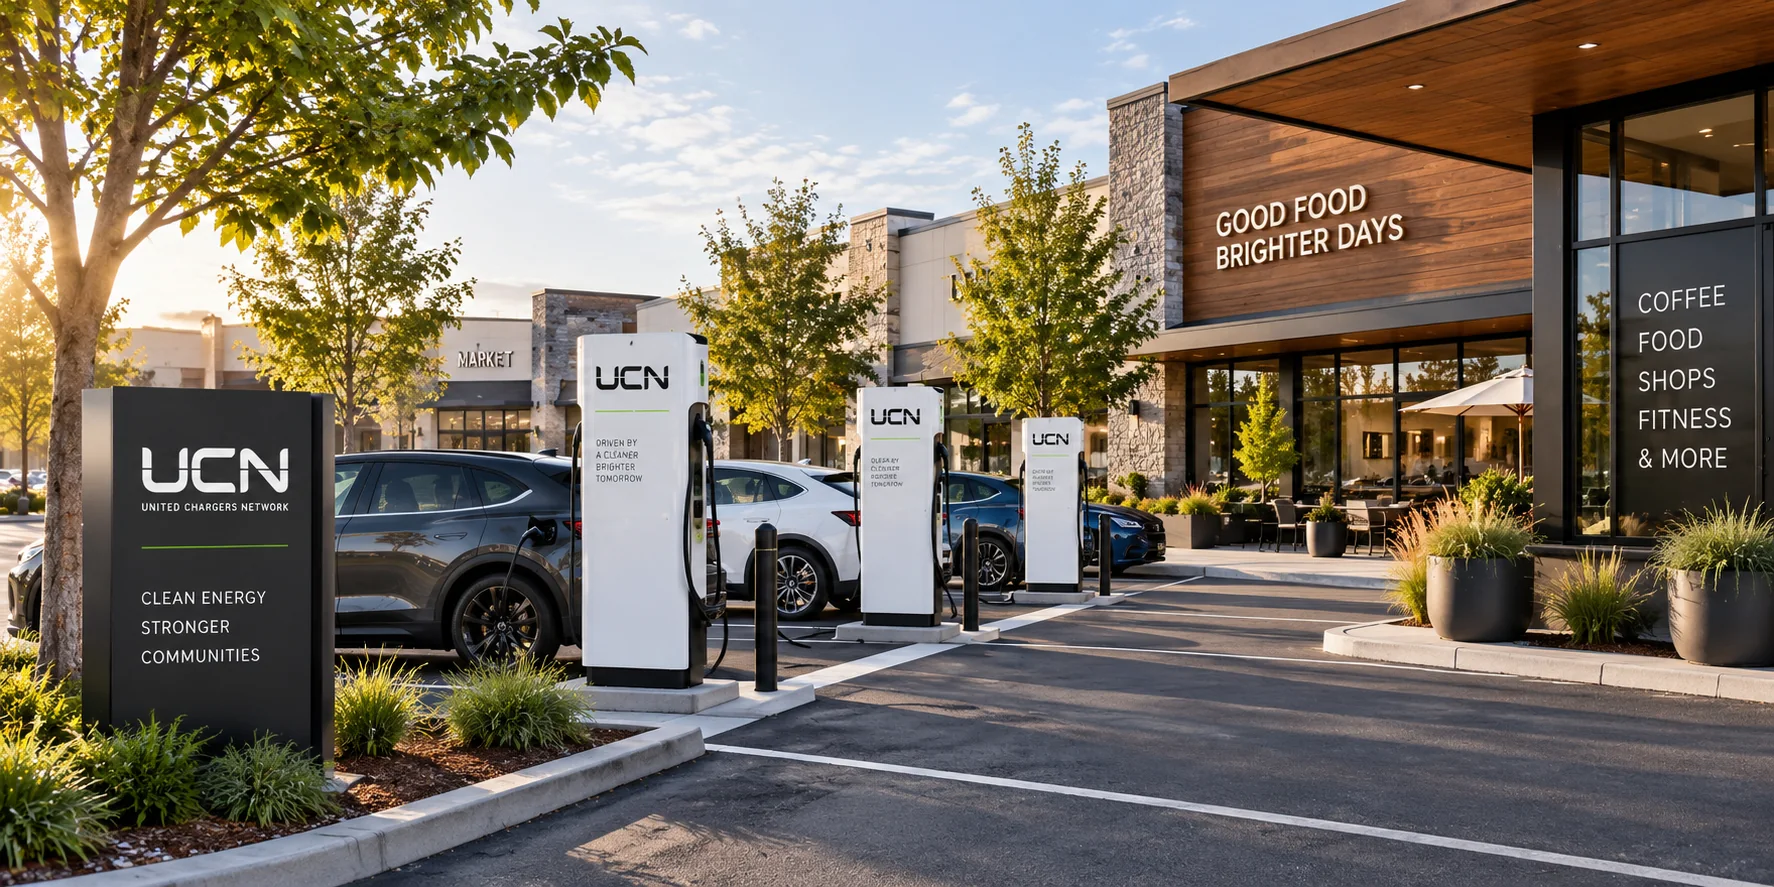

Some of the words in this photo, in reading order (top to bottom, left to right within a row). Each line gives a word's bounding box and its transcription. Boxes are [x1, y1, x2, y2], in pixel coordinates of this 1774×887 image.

[1216, 201, 1288, 238] GOOD
[1294, 184, 1368, 223] FOOD
[1216, 227, 1330, 270] BRIGHTER
[1338, 213, 1404, 250] DAYS
[1638, 284, 1726, 314] COFFEE
[1639, 327, 1703, 353] FOOD
[457, 350, 514, 368] MARKET
[595, 365, 669, 391] UCN
[1638, 367, 1716, 392] SHOPS
[870, 408, 921, 426] UCN
[1639, 406, 1732, 430] FITNESS
[596, 438, 625, 448] DRIVEN
[627, 438, 638, 448] BY
[1032, 433, 1069, 446] UCN
[596, 451, 602, 460] A
[603, 450, 639, 460] CLEANER
[1638, 447, 1653, 470] &
[1662, 447, 1728, 470] MORE
[141, 446, 289, 494] UCN
[596, 462, 636, 472] BRIGHTER
[596, 474, 643, 483] TOMORROW
[141, 502, 181, 512] UNITED
[184, 502, 238, 512] CHARGERS
[241, 502, 289, 512] NETWORK
[141, 590, 195, 606] CLEAN
[202, 590, 266, 606] ENERGY
[141, 619, 230, 635] STRONGER
[141, 647, 260, 665] COMMUNITIES
